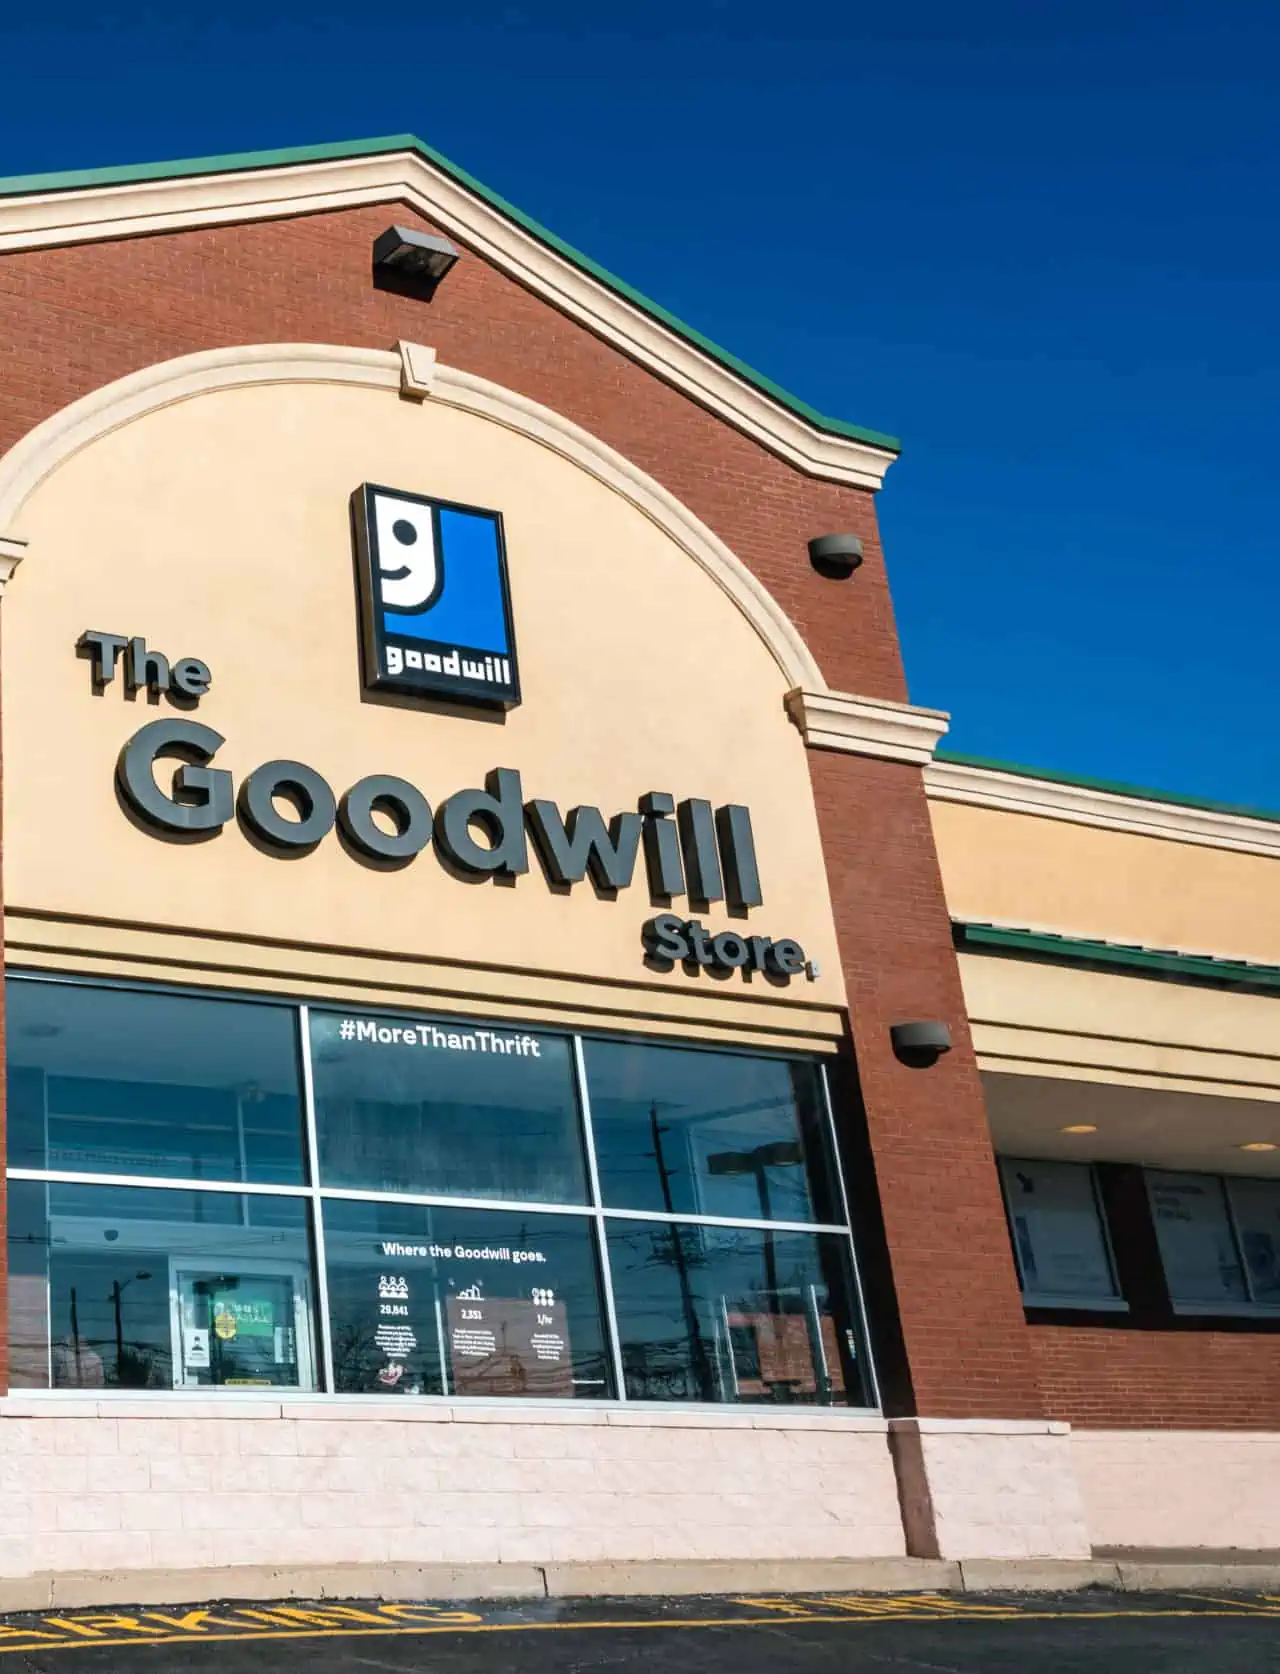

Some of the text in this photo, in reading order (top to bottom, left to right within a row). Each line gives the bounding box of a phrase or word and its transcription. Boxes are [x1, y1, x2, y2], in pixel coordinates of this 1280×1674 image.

[77, 630, 212, 697] The
[386, 645, 511, 684] goodwill
[118, 717, 763, 908] Goodwill
[643, 913, 806, 974] Store
[339, 1019, 541, 1057] #MoreThanThrift
[382, 1242, 426, 1257] Where
[429, 1245, 452, 1258] the
[454, 1246, 510, 1261] Goodwill
